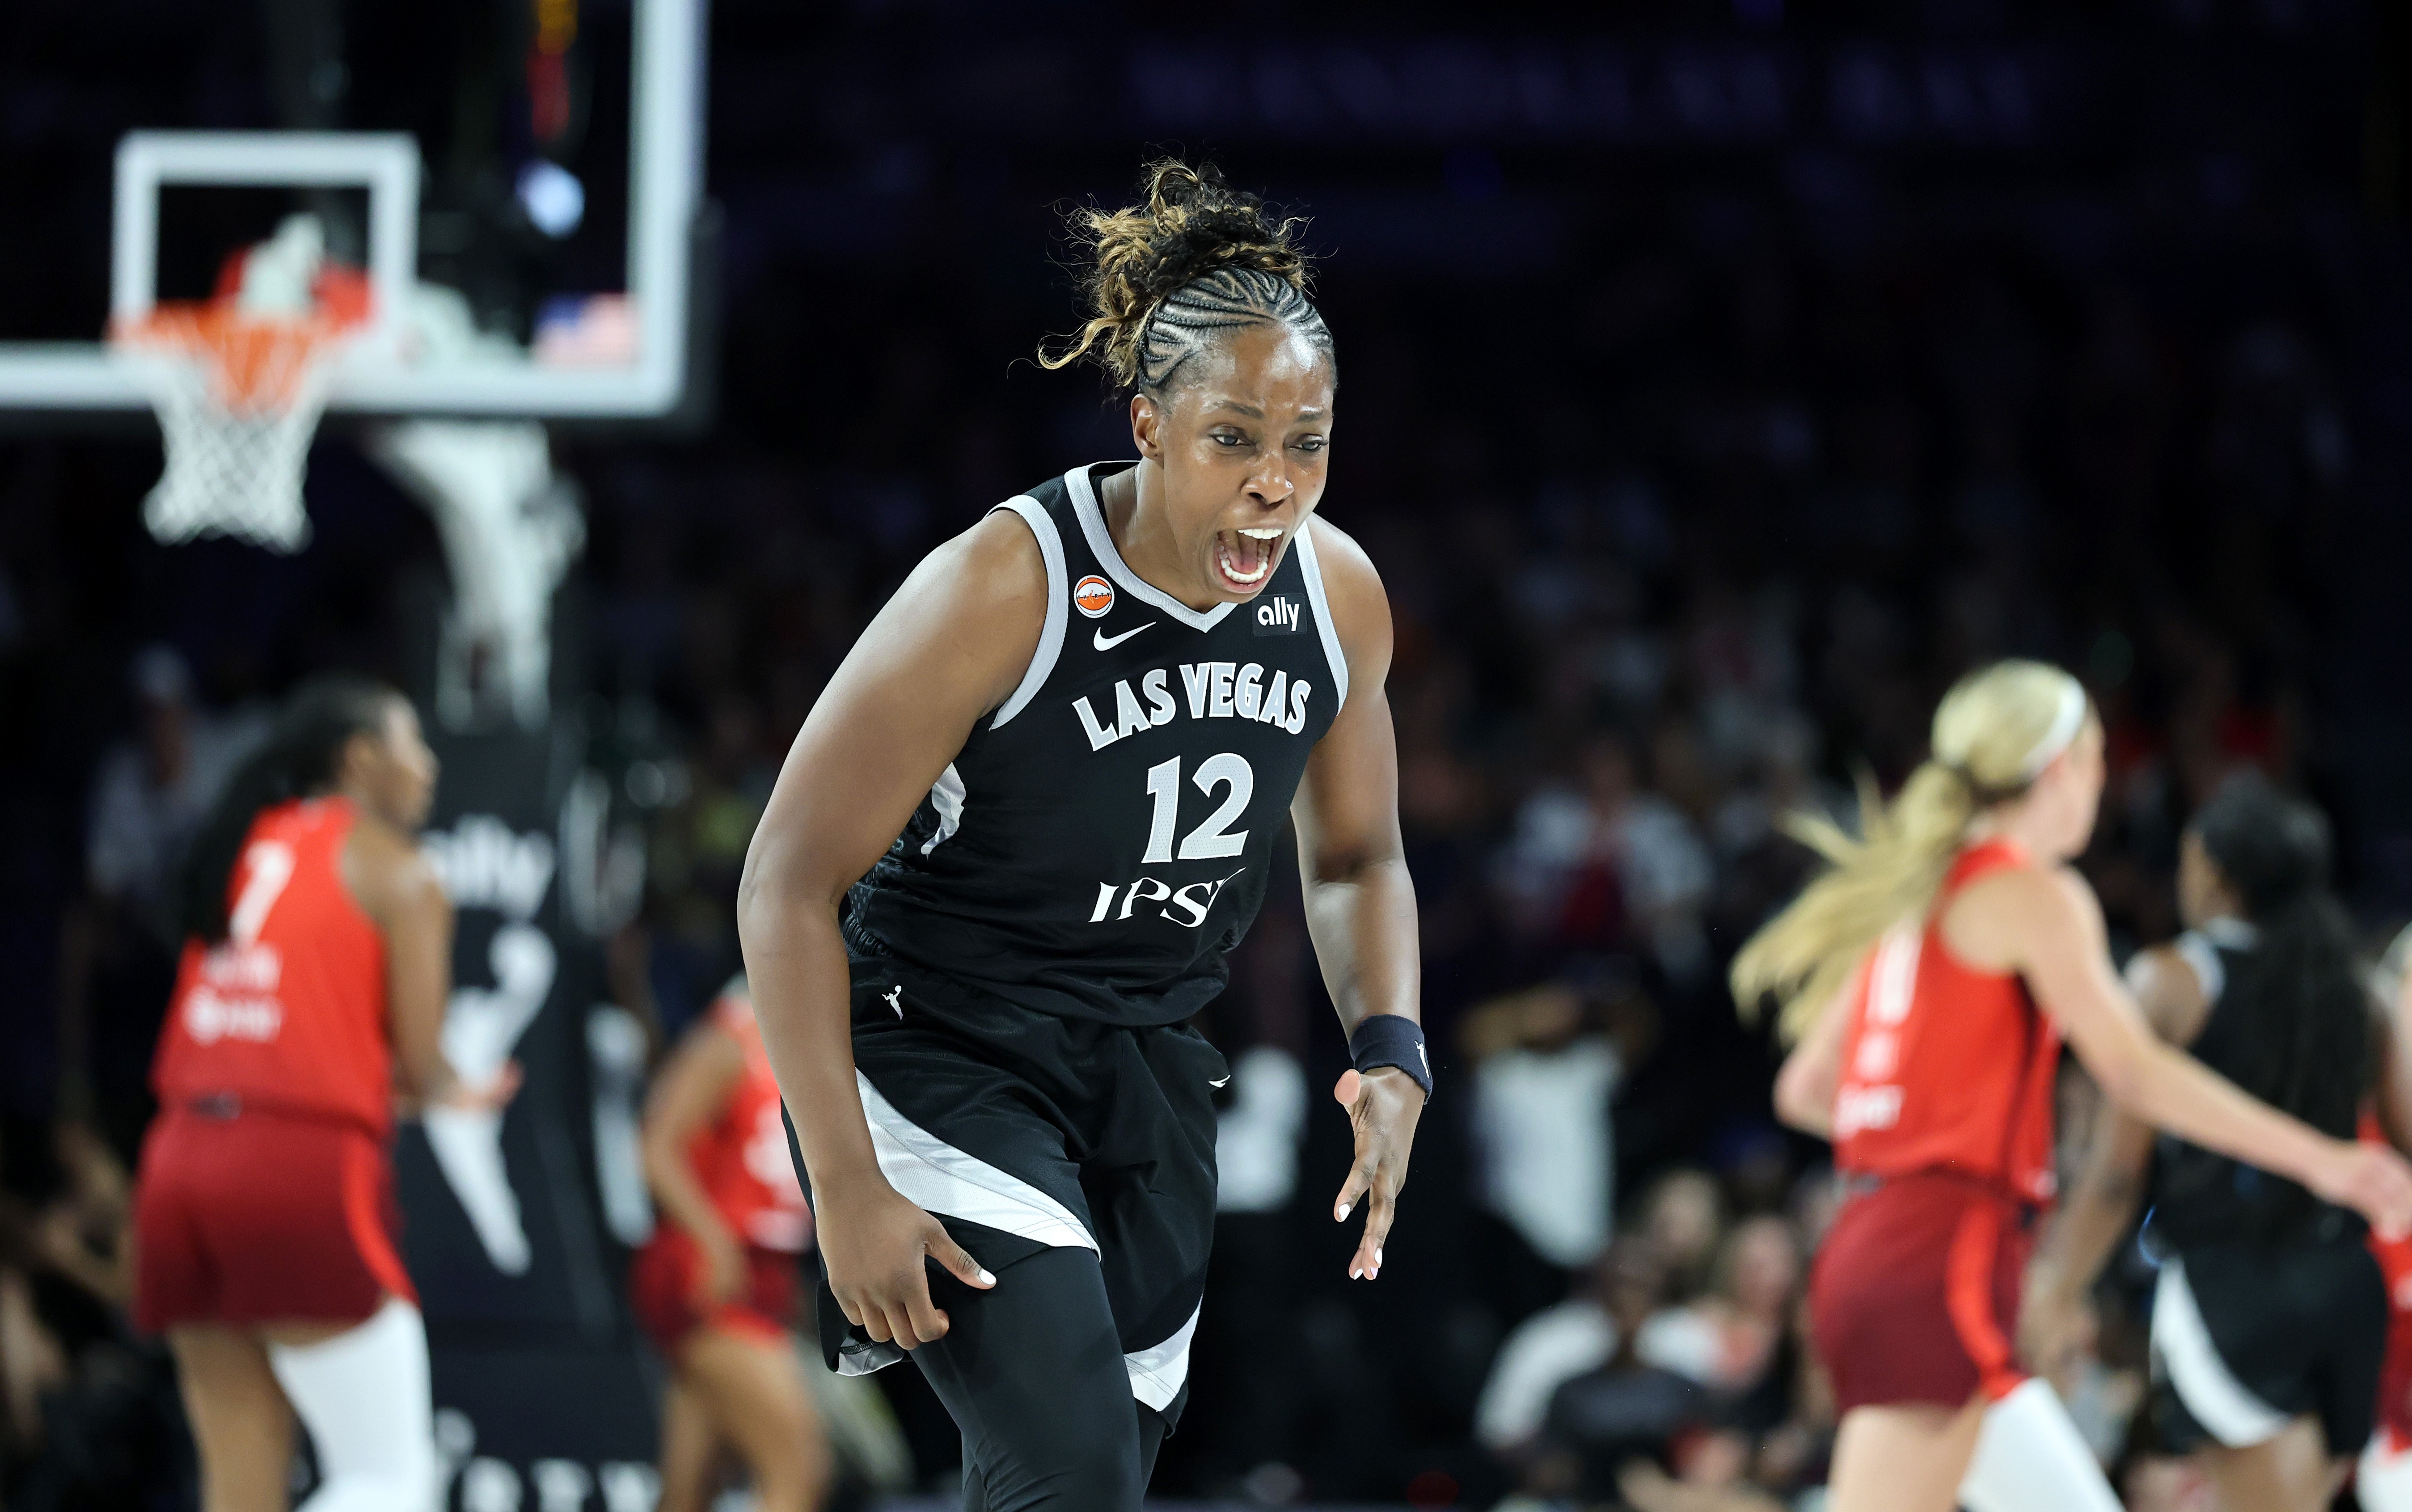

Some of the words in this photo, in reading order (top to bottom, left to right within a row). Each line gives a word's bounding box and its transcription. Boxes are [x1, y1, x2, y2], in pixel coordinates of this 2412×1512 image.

[1257, 596, 1300, 632] ally
[1072, 669, 1176, 752] LAS
[1179, 662, 1311, 735] VEGAS
[1141, 752, 1254, 864] 12
